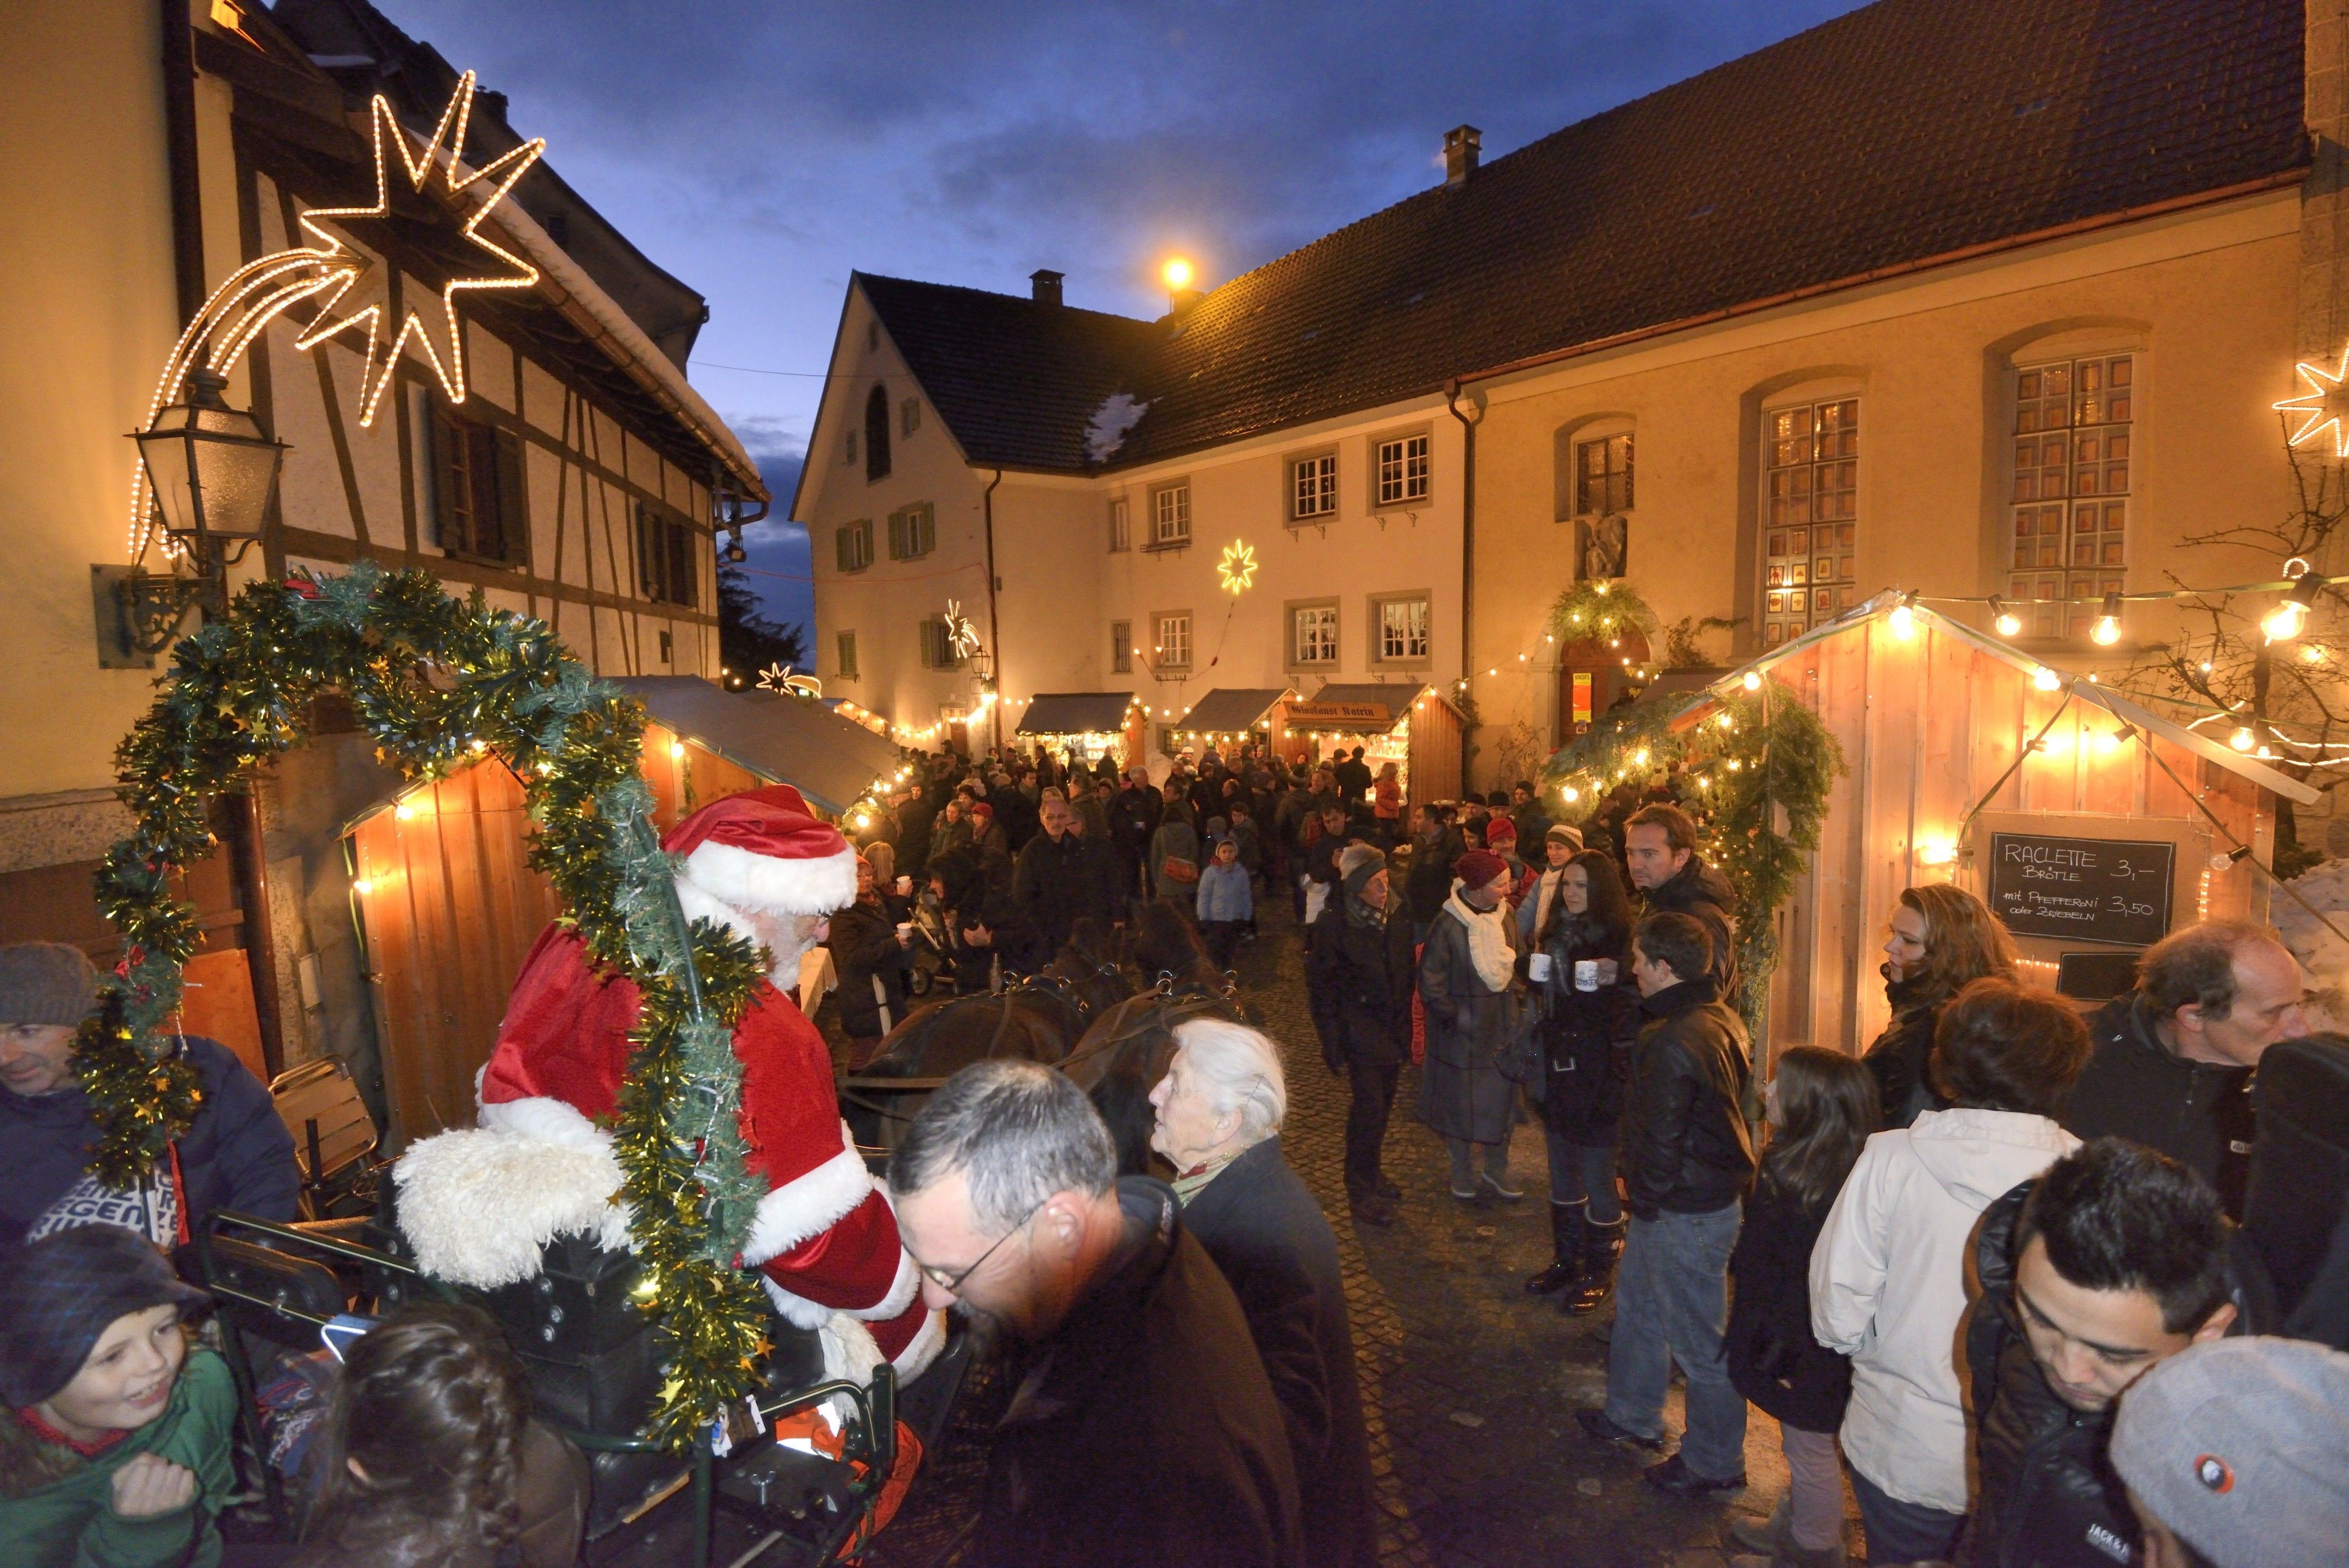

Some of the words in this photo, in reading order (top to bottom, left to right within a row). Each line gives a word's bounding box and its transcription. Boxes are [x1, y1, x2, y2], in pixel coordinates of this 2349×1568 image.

[1342, 707, 1374, 716] Katrin
[2005, 844, 2097, 867] RACLETTE
[2003, 890, 2022, 901] mit
[2107, 896, 2153, 918] 3,50
[2009, 906, 2032, 915] oder
